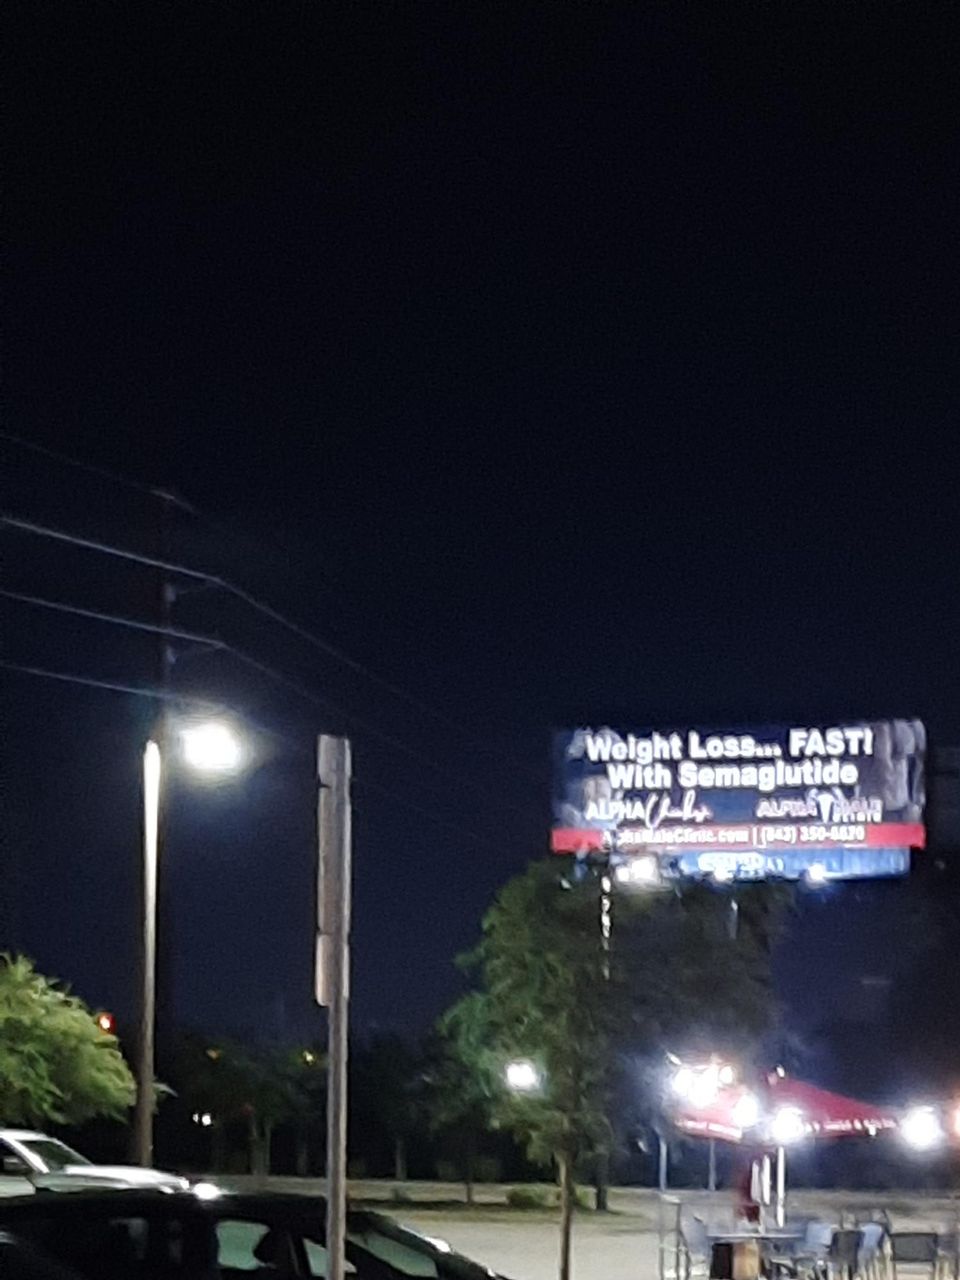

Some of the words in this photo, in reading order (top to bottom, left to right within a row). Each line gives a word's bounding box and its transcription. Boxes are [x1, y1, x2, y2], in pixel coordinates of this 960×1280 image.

[586, 732, 682, 764] Weight
[790, 727, 873, 755] FAST!
[607, 762, 671, 788] With
[678, 758, 858, 791] Semaglutide
